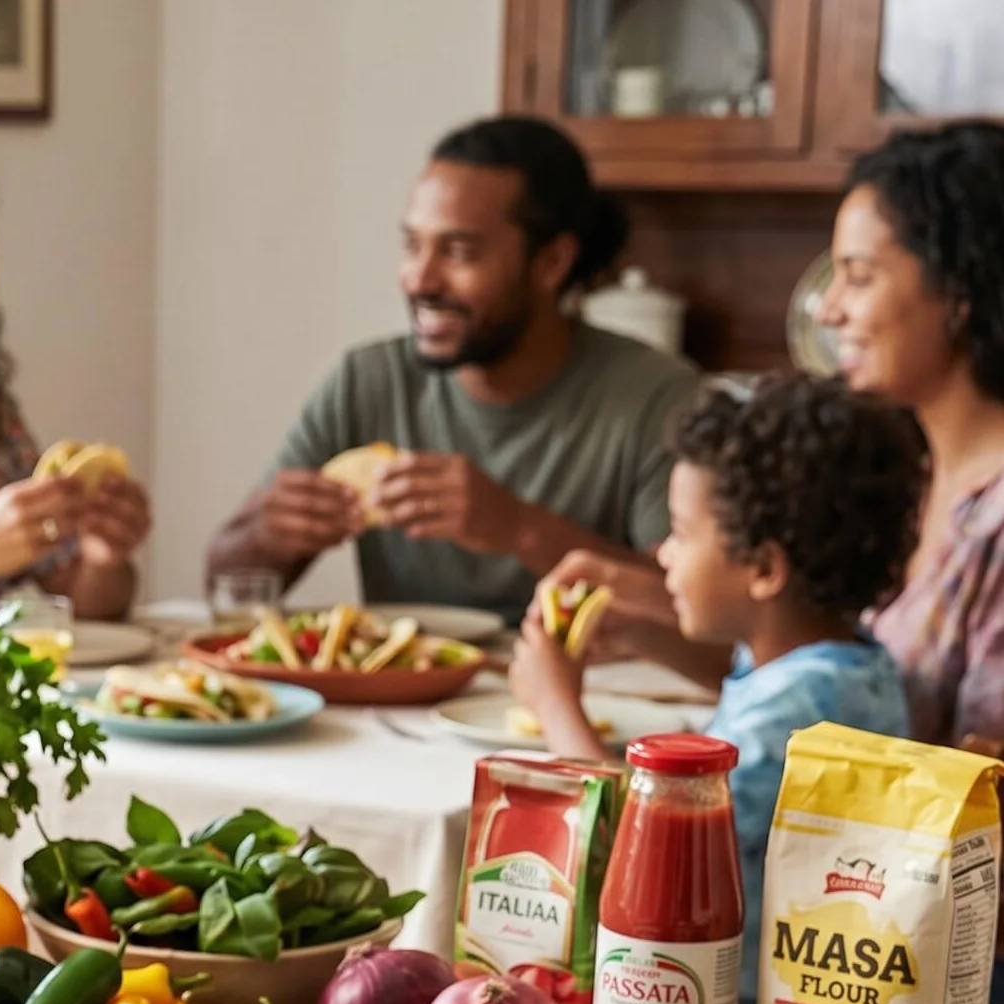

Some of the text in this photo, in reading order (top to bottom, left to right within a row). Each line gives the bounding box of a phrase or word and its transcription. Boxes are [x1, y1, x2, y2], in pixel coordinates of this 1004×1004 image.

[478, 891, 558, 925] ITALIAA
[774, 920, 916, 985] MASA
[602, 971, 690, 1004] PASSATA
